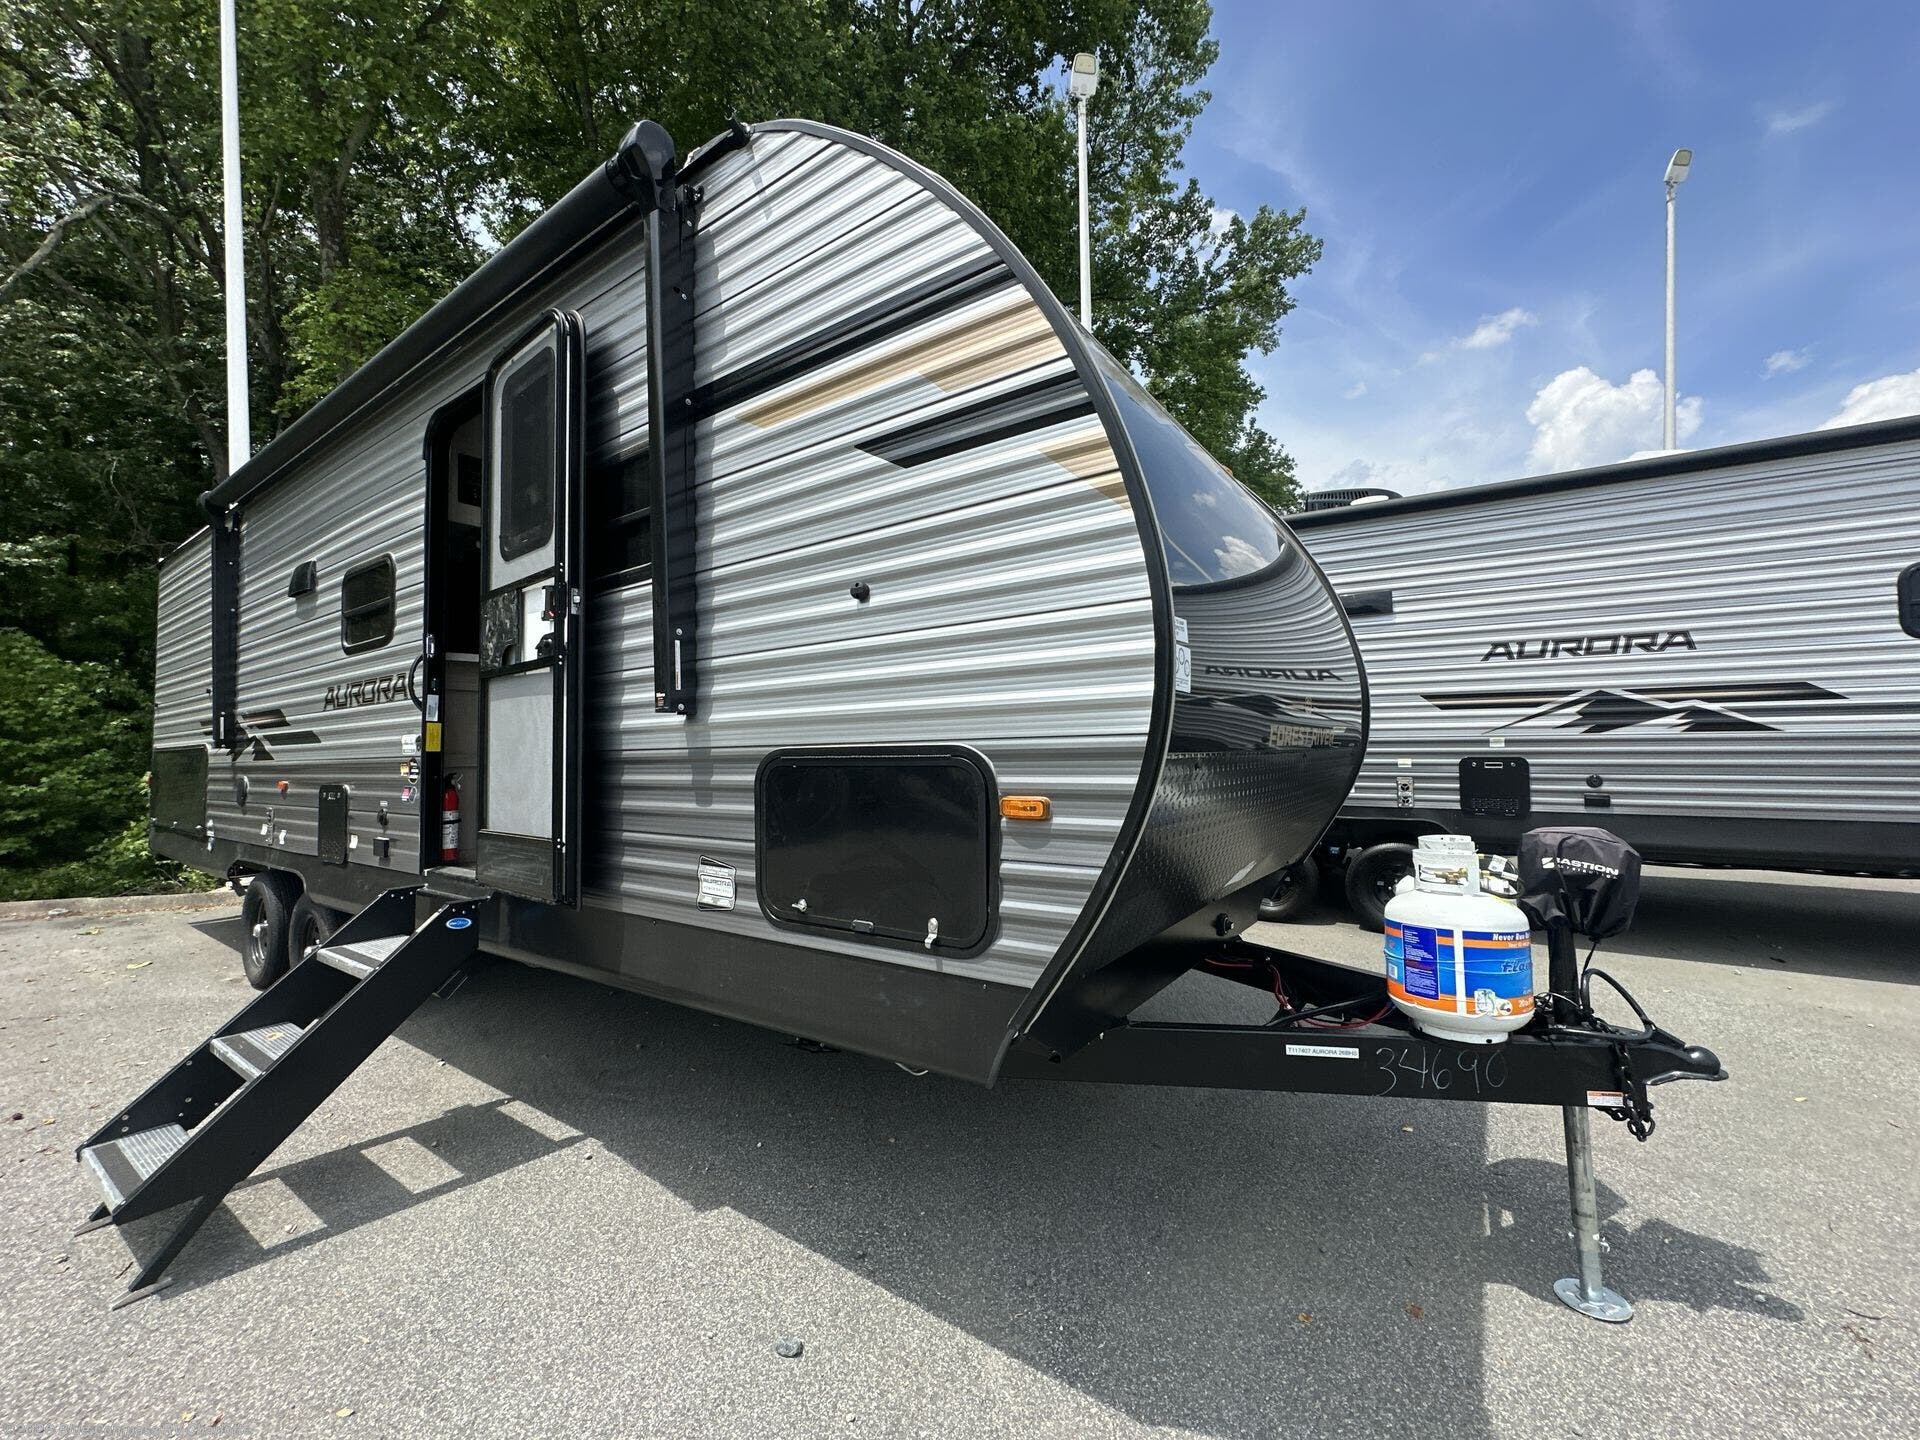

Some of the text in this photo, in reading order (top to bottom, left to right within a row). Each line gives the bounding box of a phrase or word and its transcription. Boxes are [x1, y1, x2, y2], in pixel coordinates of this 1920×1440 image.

[1480, 631, 1697, 661] AURORA
[323, 673, 408, 711] AURORA
[1311, 1048, 1338, 1056] AURORA
[1376, 1047, 1507, 1097] 34690
